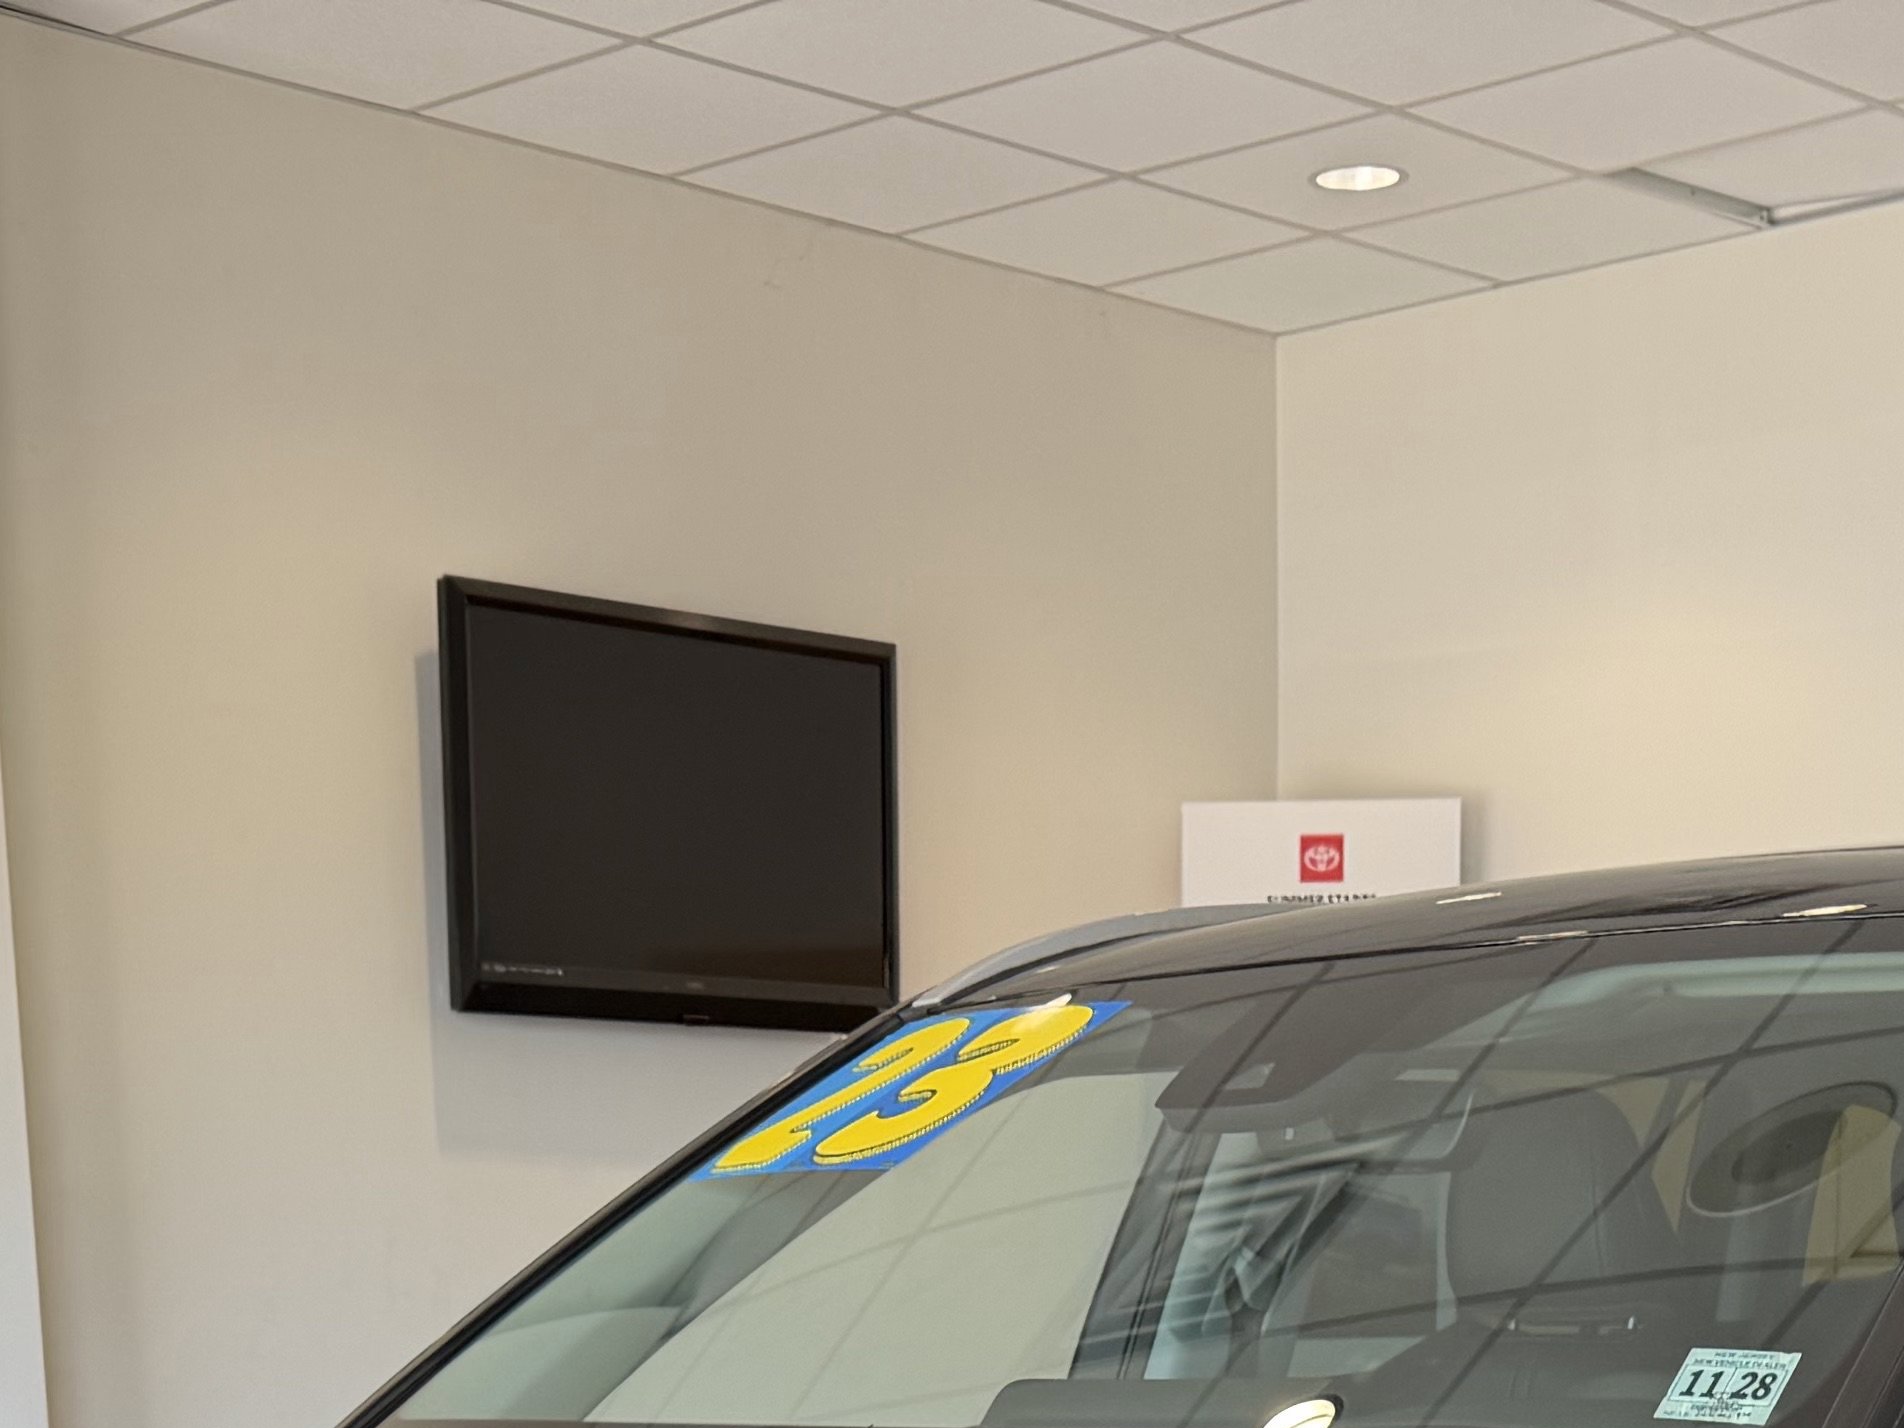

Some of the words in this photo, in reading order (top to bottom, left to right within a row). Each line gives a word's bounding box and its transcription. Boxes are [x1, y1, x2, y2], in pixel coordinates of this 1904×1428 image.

[713, 1000, 1096, 1172] 23
[1678, 1369, 1724, 1399] 11
[1729, 1371, 1778, 1401] 28
